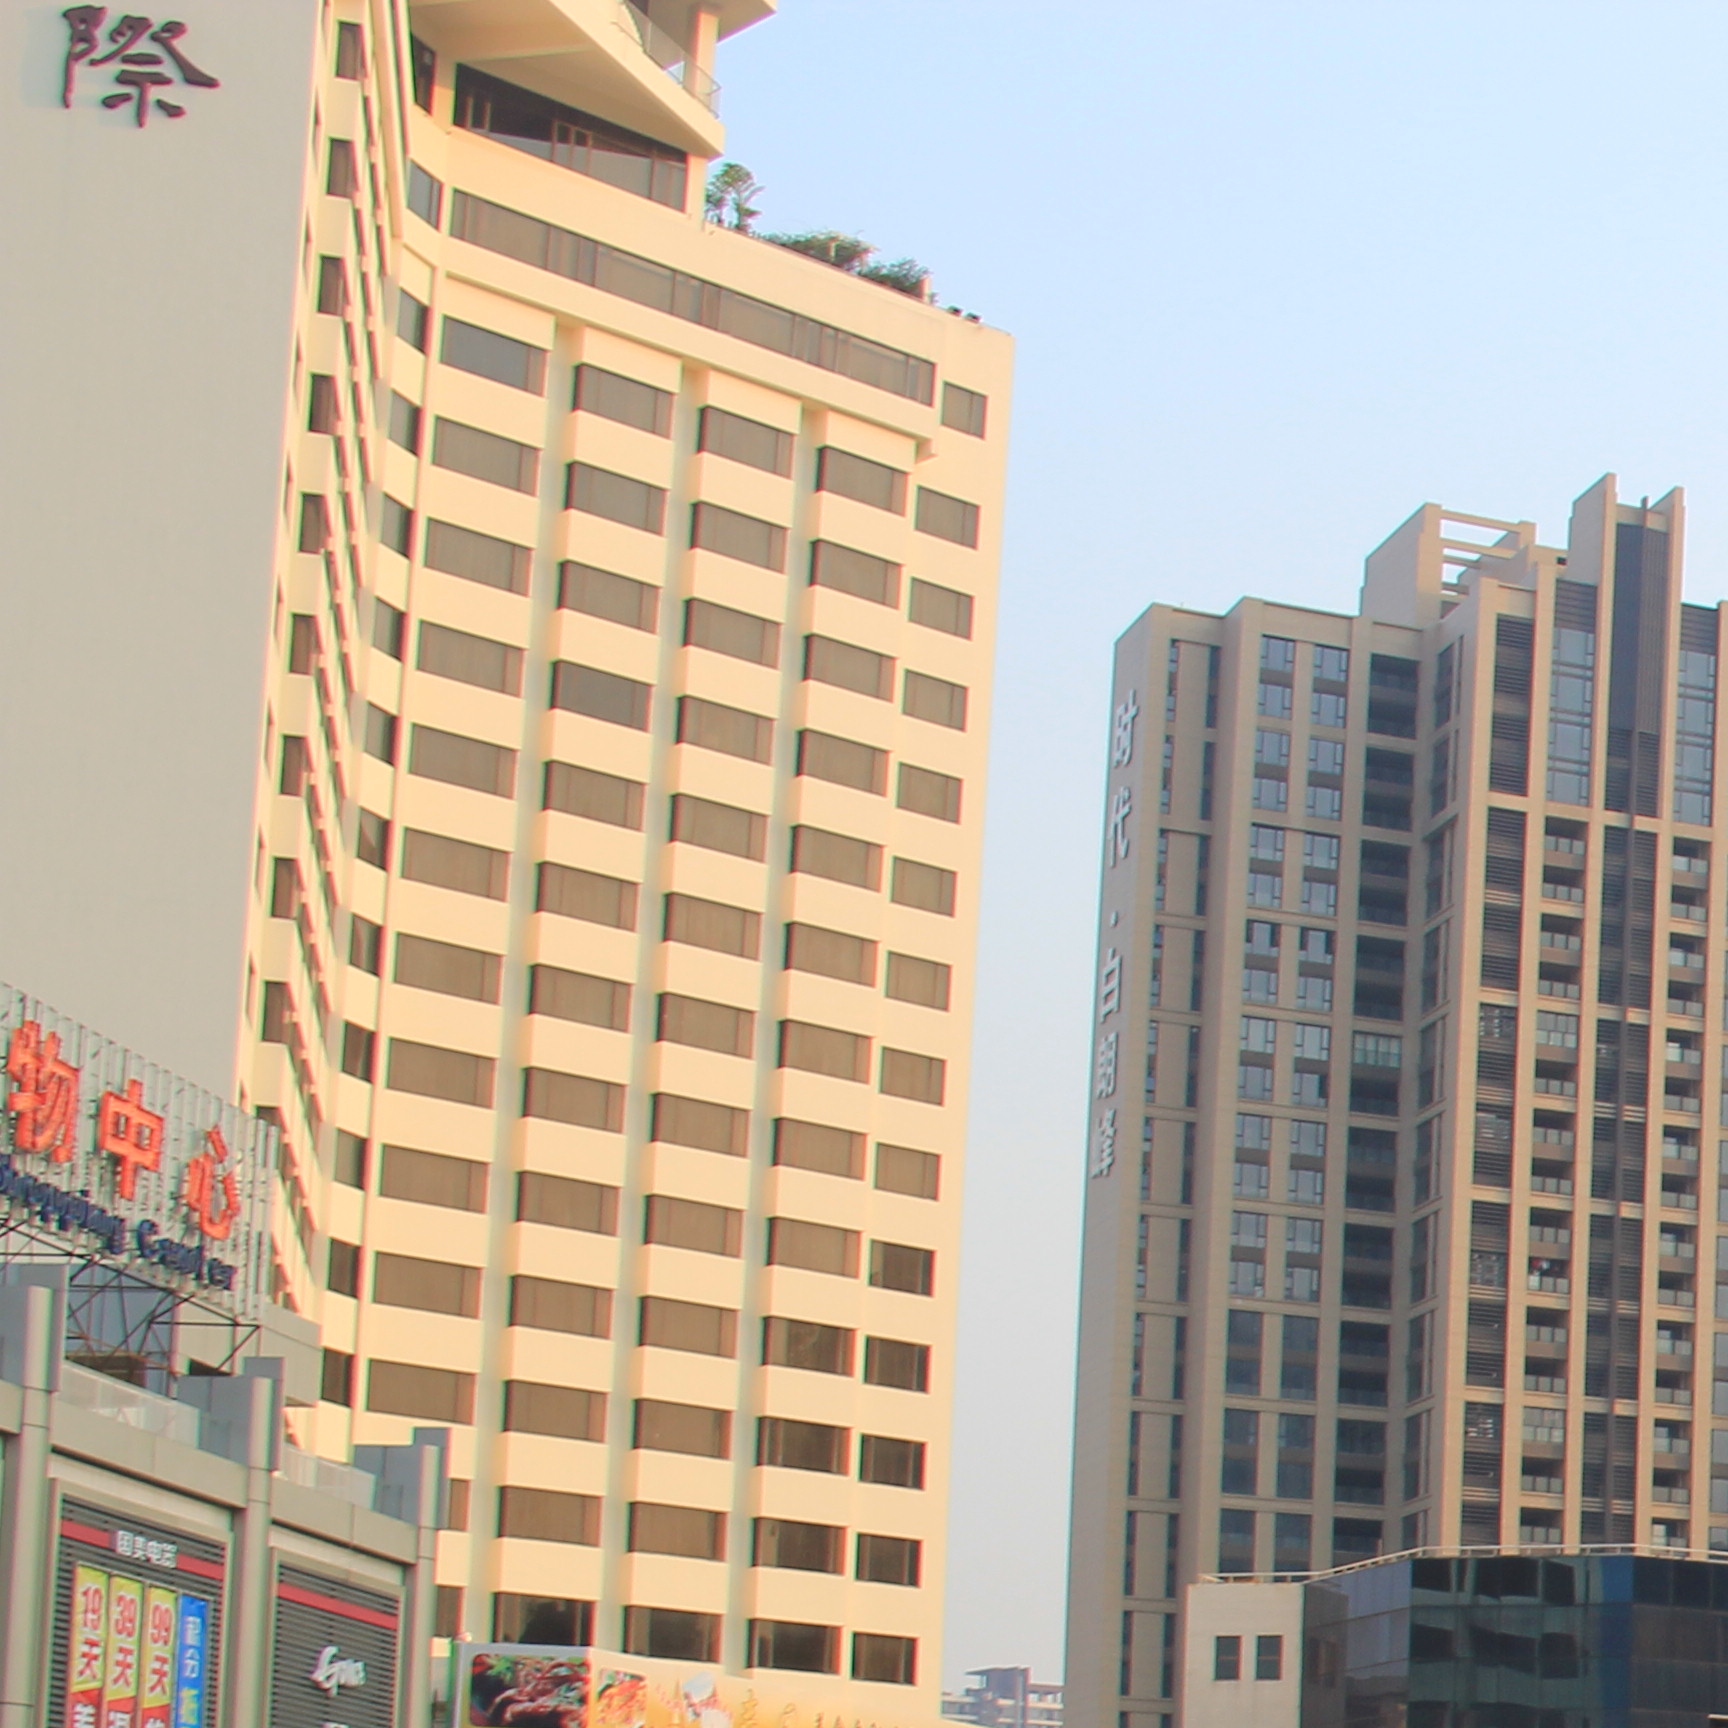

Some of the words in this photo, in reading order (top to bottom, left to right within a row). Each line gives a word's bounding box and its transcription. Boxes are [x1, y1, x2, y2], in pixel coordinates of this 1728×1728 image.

[63, 5, 221, 129] 際
[116, 1529, 178, 1569] 国美电器
